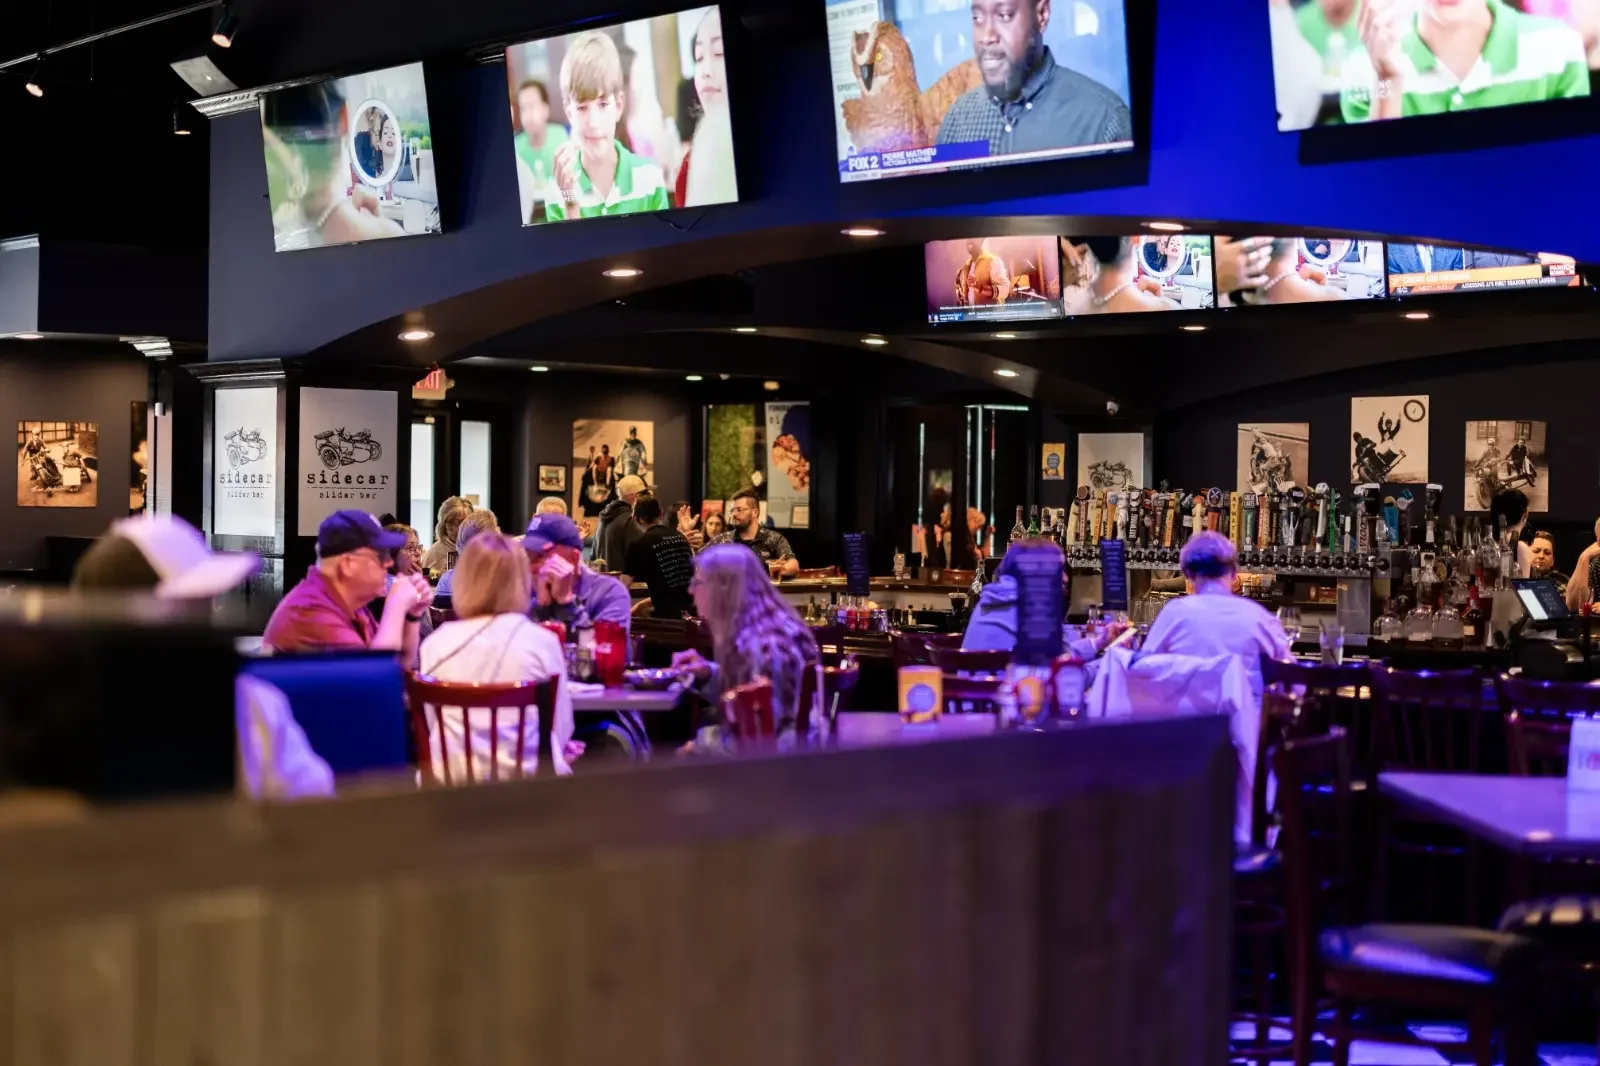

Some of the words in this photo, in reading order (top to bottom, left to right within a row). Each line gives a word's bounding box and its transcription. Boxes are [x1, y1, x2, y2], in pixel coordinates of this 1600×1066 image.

[848, 156, 870, 171] FOX
[869, 155, 879, 169] 2
[219, 470, 272, 484] sidecar
[307, 470, 388, 485] sidecar
[227, 491, 250, 499] slider
[252, 491, 264, 499] bar
[319, 491, 355, 499] slider
[359, 491, 377, 500] bar
